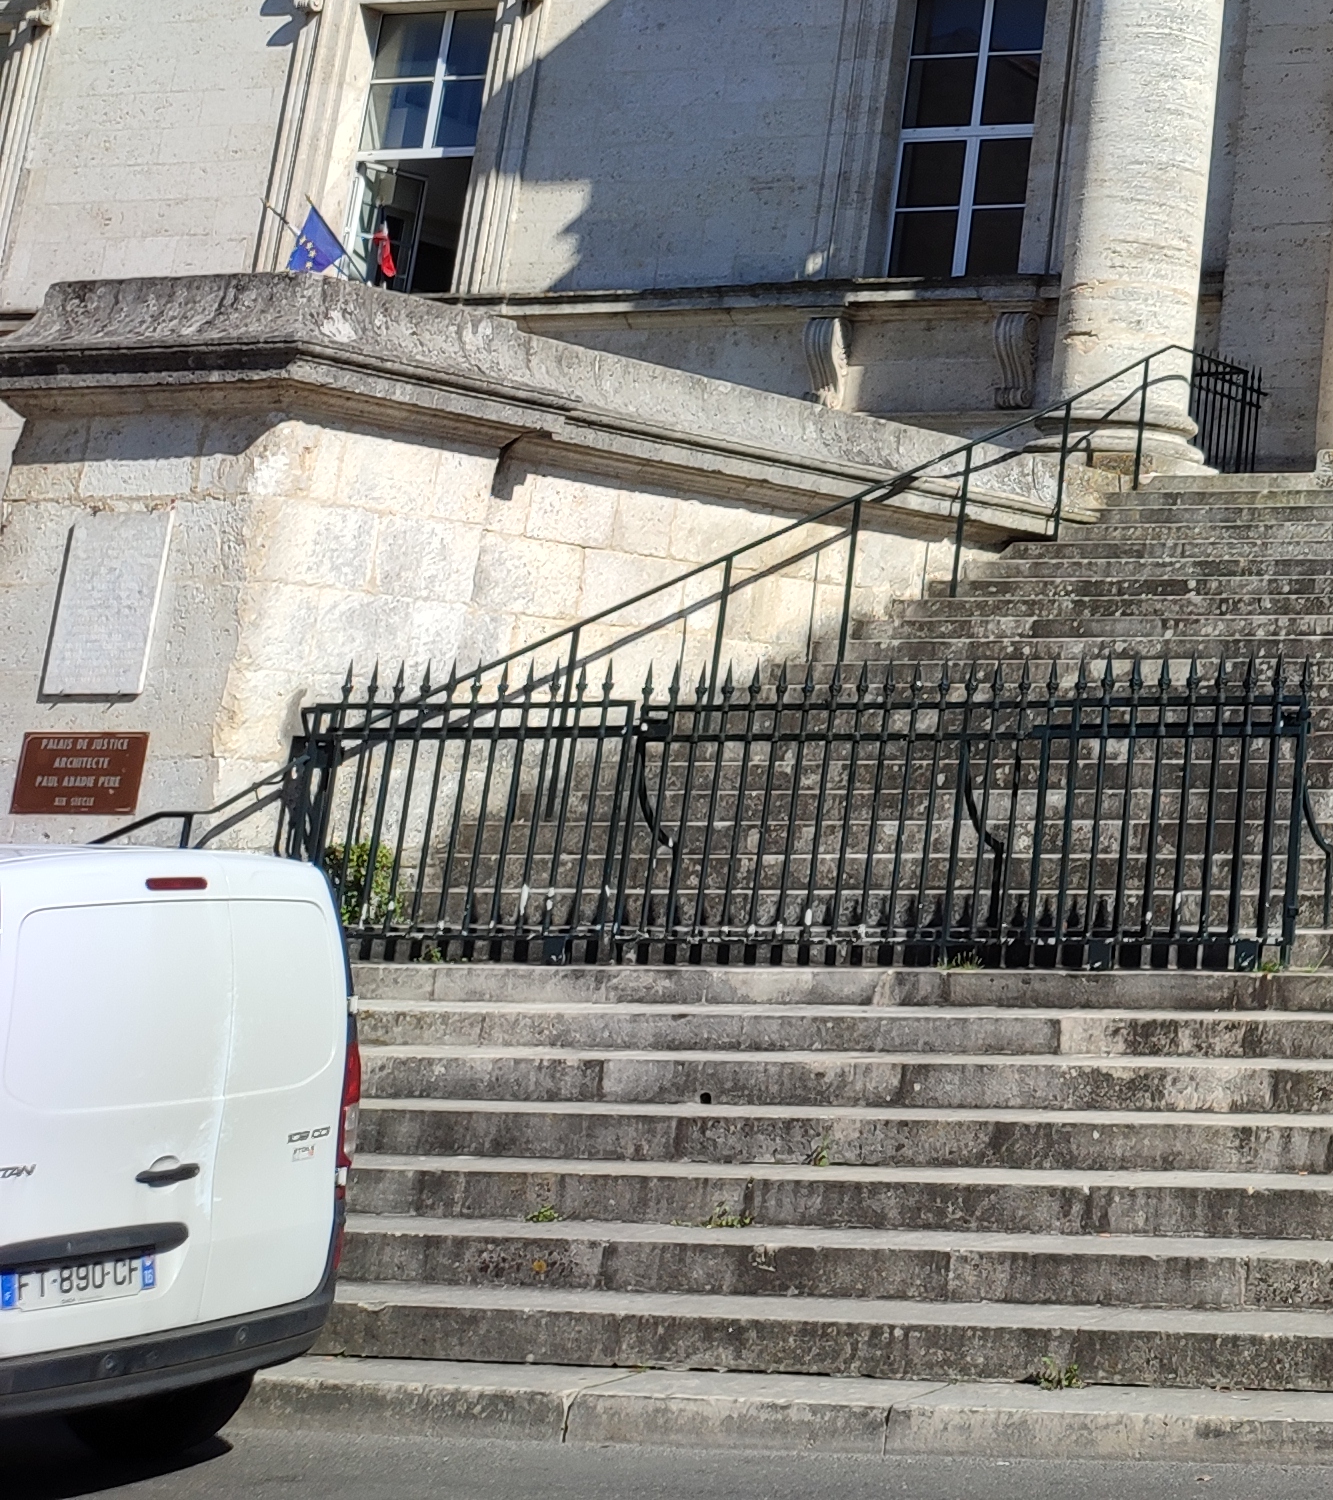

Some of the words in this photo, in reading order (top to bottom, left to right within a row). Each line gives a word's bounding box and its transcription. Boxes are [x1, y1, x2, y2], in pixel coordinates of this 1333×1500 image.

[41, 739, 73, 750] PALAIS
[76, 739, 89, 750] DE
[91, 739, 129, 750] JUSTICE
[53, 757, 111, 769] ARCHITECTE
[35, 776, 59, 788] PAUL
